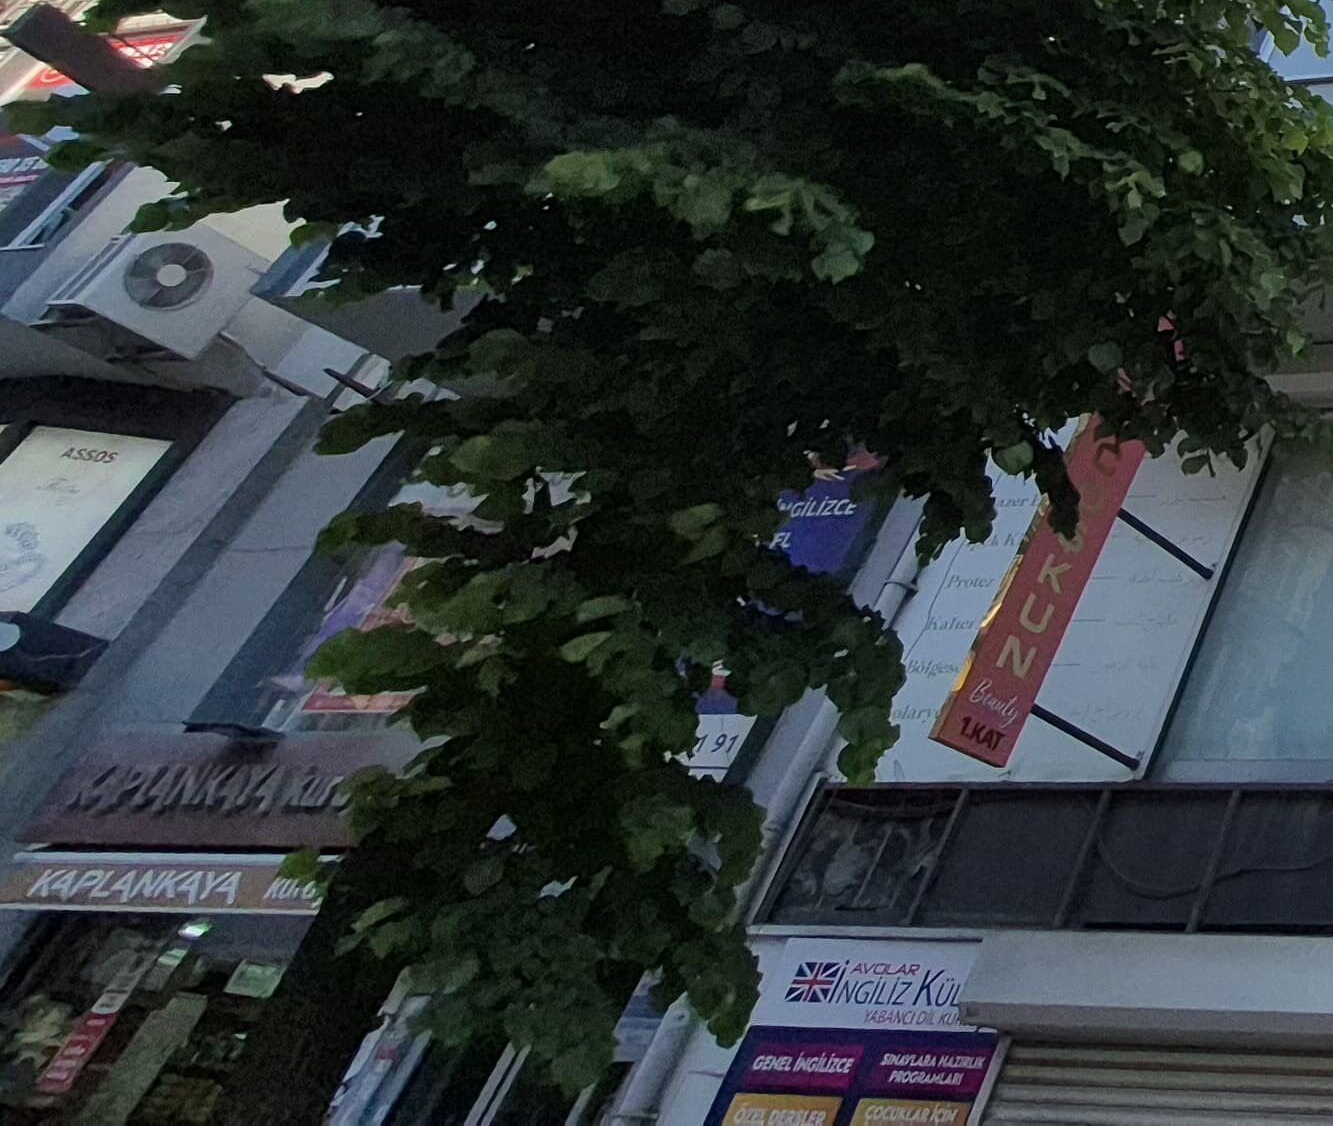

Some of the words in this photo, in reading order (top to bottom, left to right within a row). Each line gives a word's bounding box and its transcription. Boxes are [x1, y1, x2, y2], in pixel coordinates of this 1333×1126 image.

[60, 447, 118, 464] ASSOS
[946, 574, 995, 589] Protez
[969, 678, 1018, 728] Beauty
[710, 733, 740, 753] 91
[959, 716, 1006, 751] 1.KAT
[26, 869, 244, 906] KAPLANKAYA
[852, 963, 921, 976] AVCILAR
[827, 960, 913, 1005] İNGİLİZ
[864, 1009, 915, 1025] YABANCI
[916, 1008, 938, 1025] DİL
[752, 1055, 793, 1072] GENEL
[793, 1052, 855, 1074] İNGİLİZCE
[880, 1052, 937, 1067] SINAVLARA
[937, 1054, 987, 1069] HAZIRLIK
[888, 1070, 963, 1086] PROGRAMLARI
[733, 1104, 767, 1125] ÖZEL
